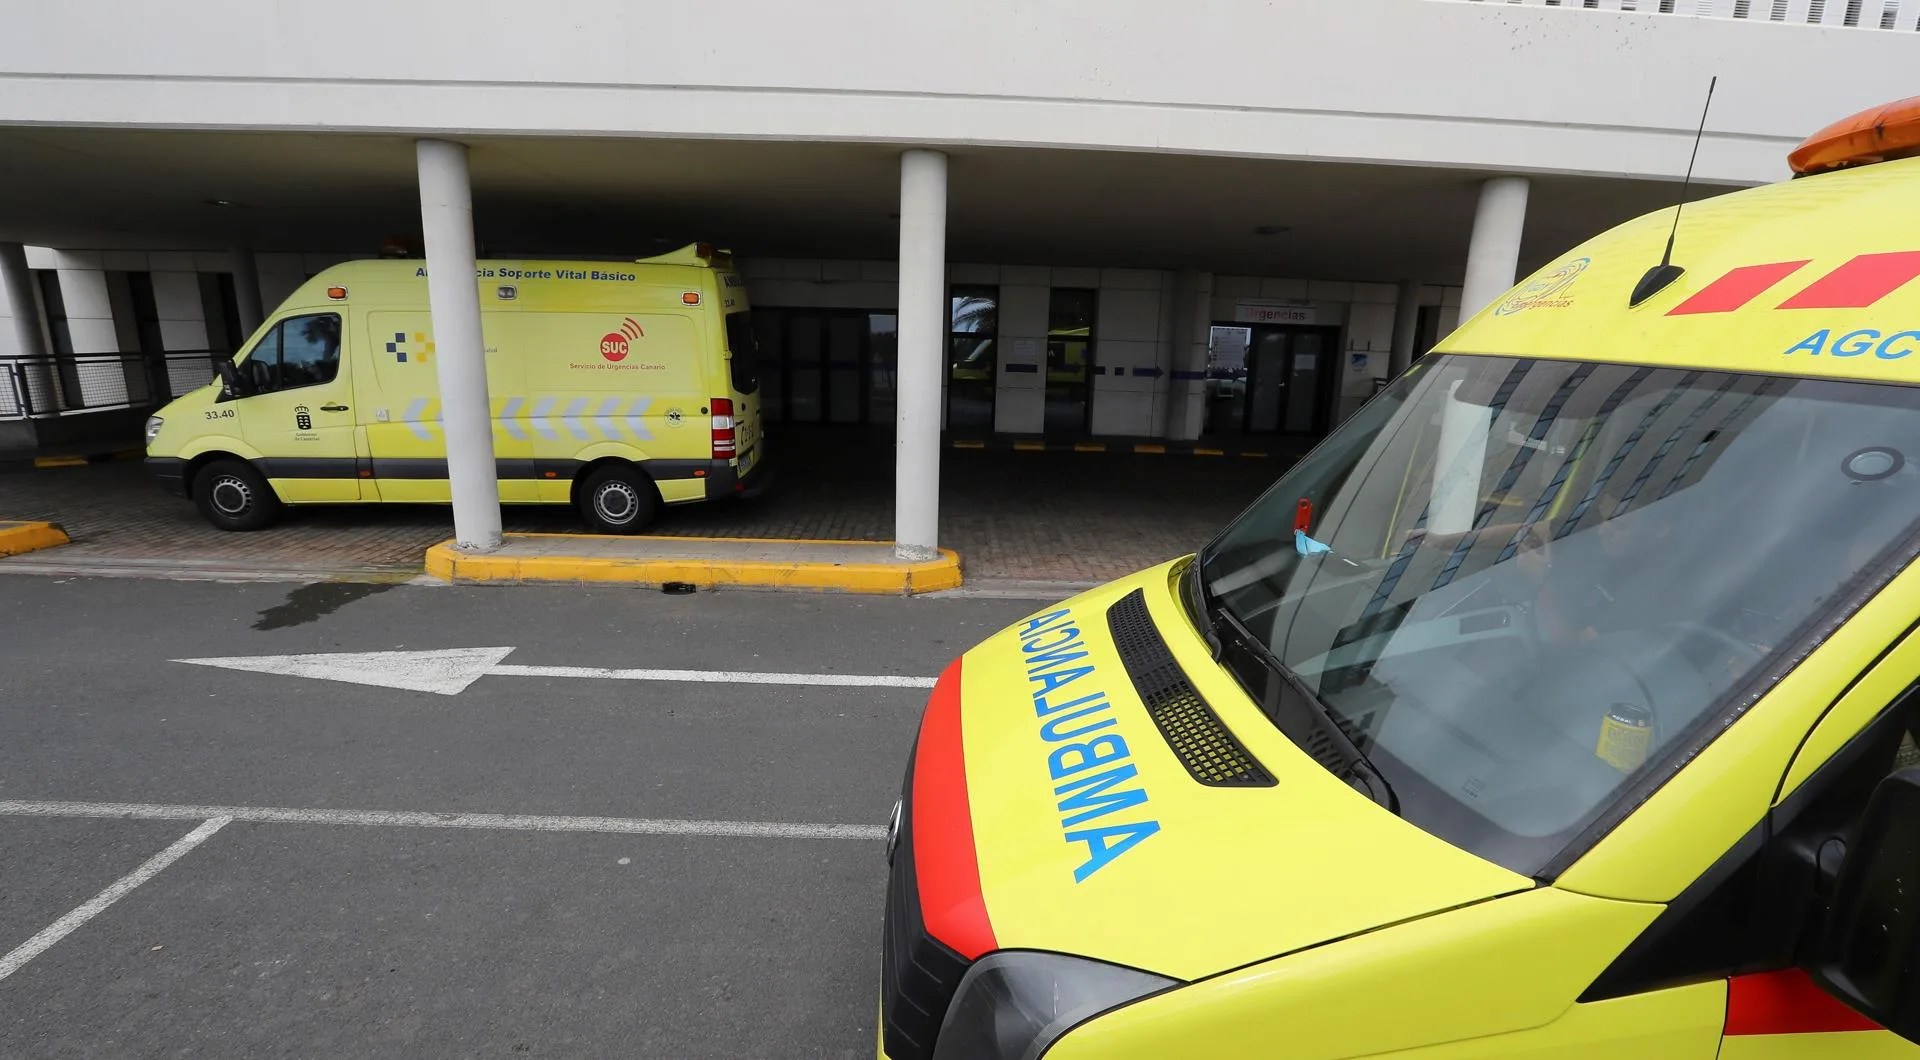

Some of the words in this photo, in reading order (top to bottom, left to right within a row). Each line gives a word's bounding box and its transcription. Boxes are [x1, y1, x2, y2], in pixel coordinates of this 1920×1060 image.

[499, 268, 551, 280] Soporte
[556, 269, 587, 280] Vital
[591, 270, 636, 281] Básico
[1246, 307, 1305, 321] Urgencias
[601, 341, 627, 354] SUC
[606, 363, 639, 371] Urgencias
[205, 409, 235, 420] 33.40
